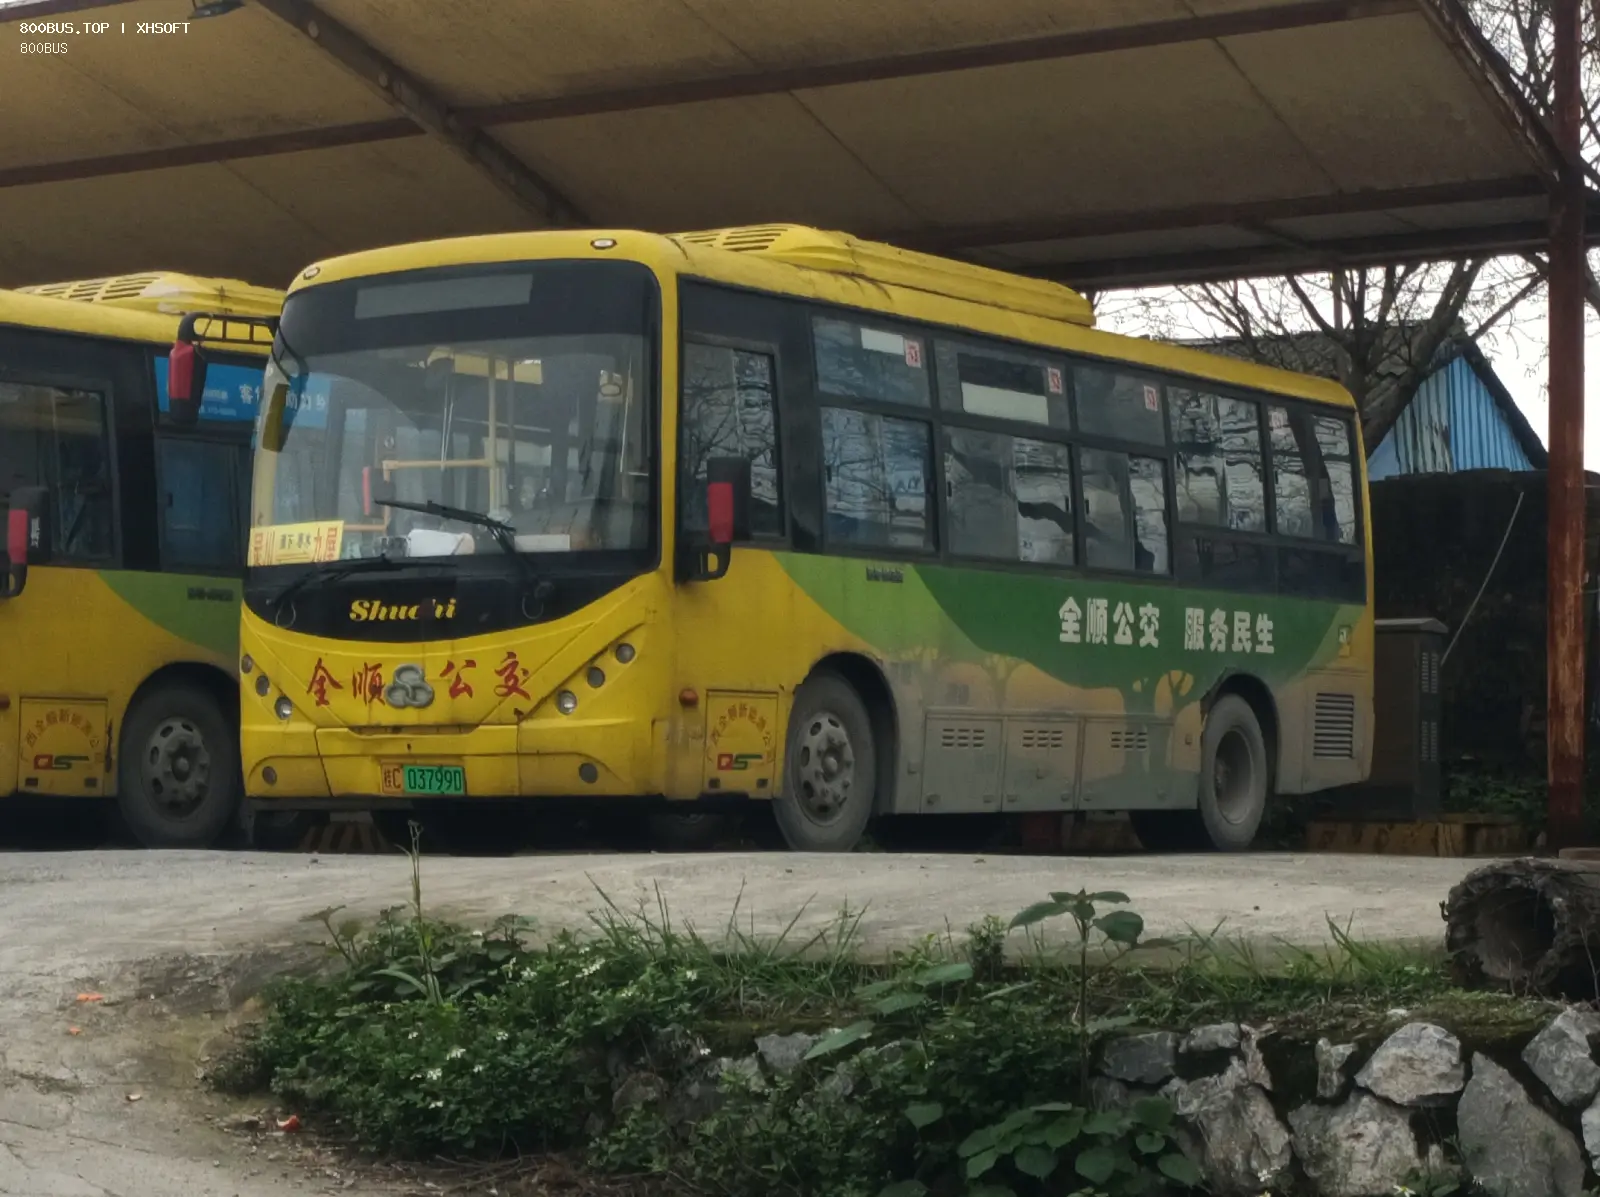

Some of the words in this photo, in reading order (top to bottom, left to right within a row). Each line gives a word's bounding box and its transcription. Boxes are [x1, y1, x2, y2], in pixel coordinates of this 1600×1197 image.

[1058, 596, 1160, 648] 全顺公交
[1184, 607, 1275, 654] 服务民生
[438, 651, 532, 700] 公交
